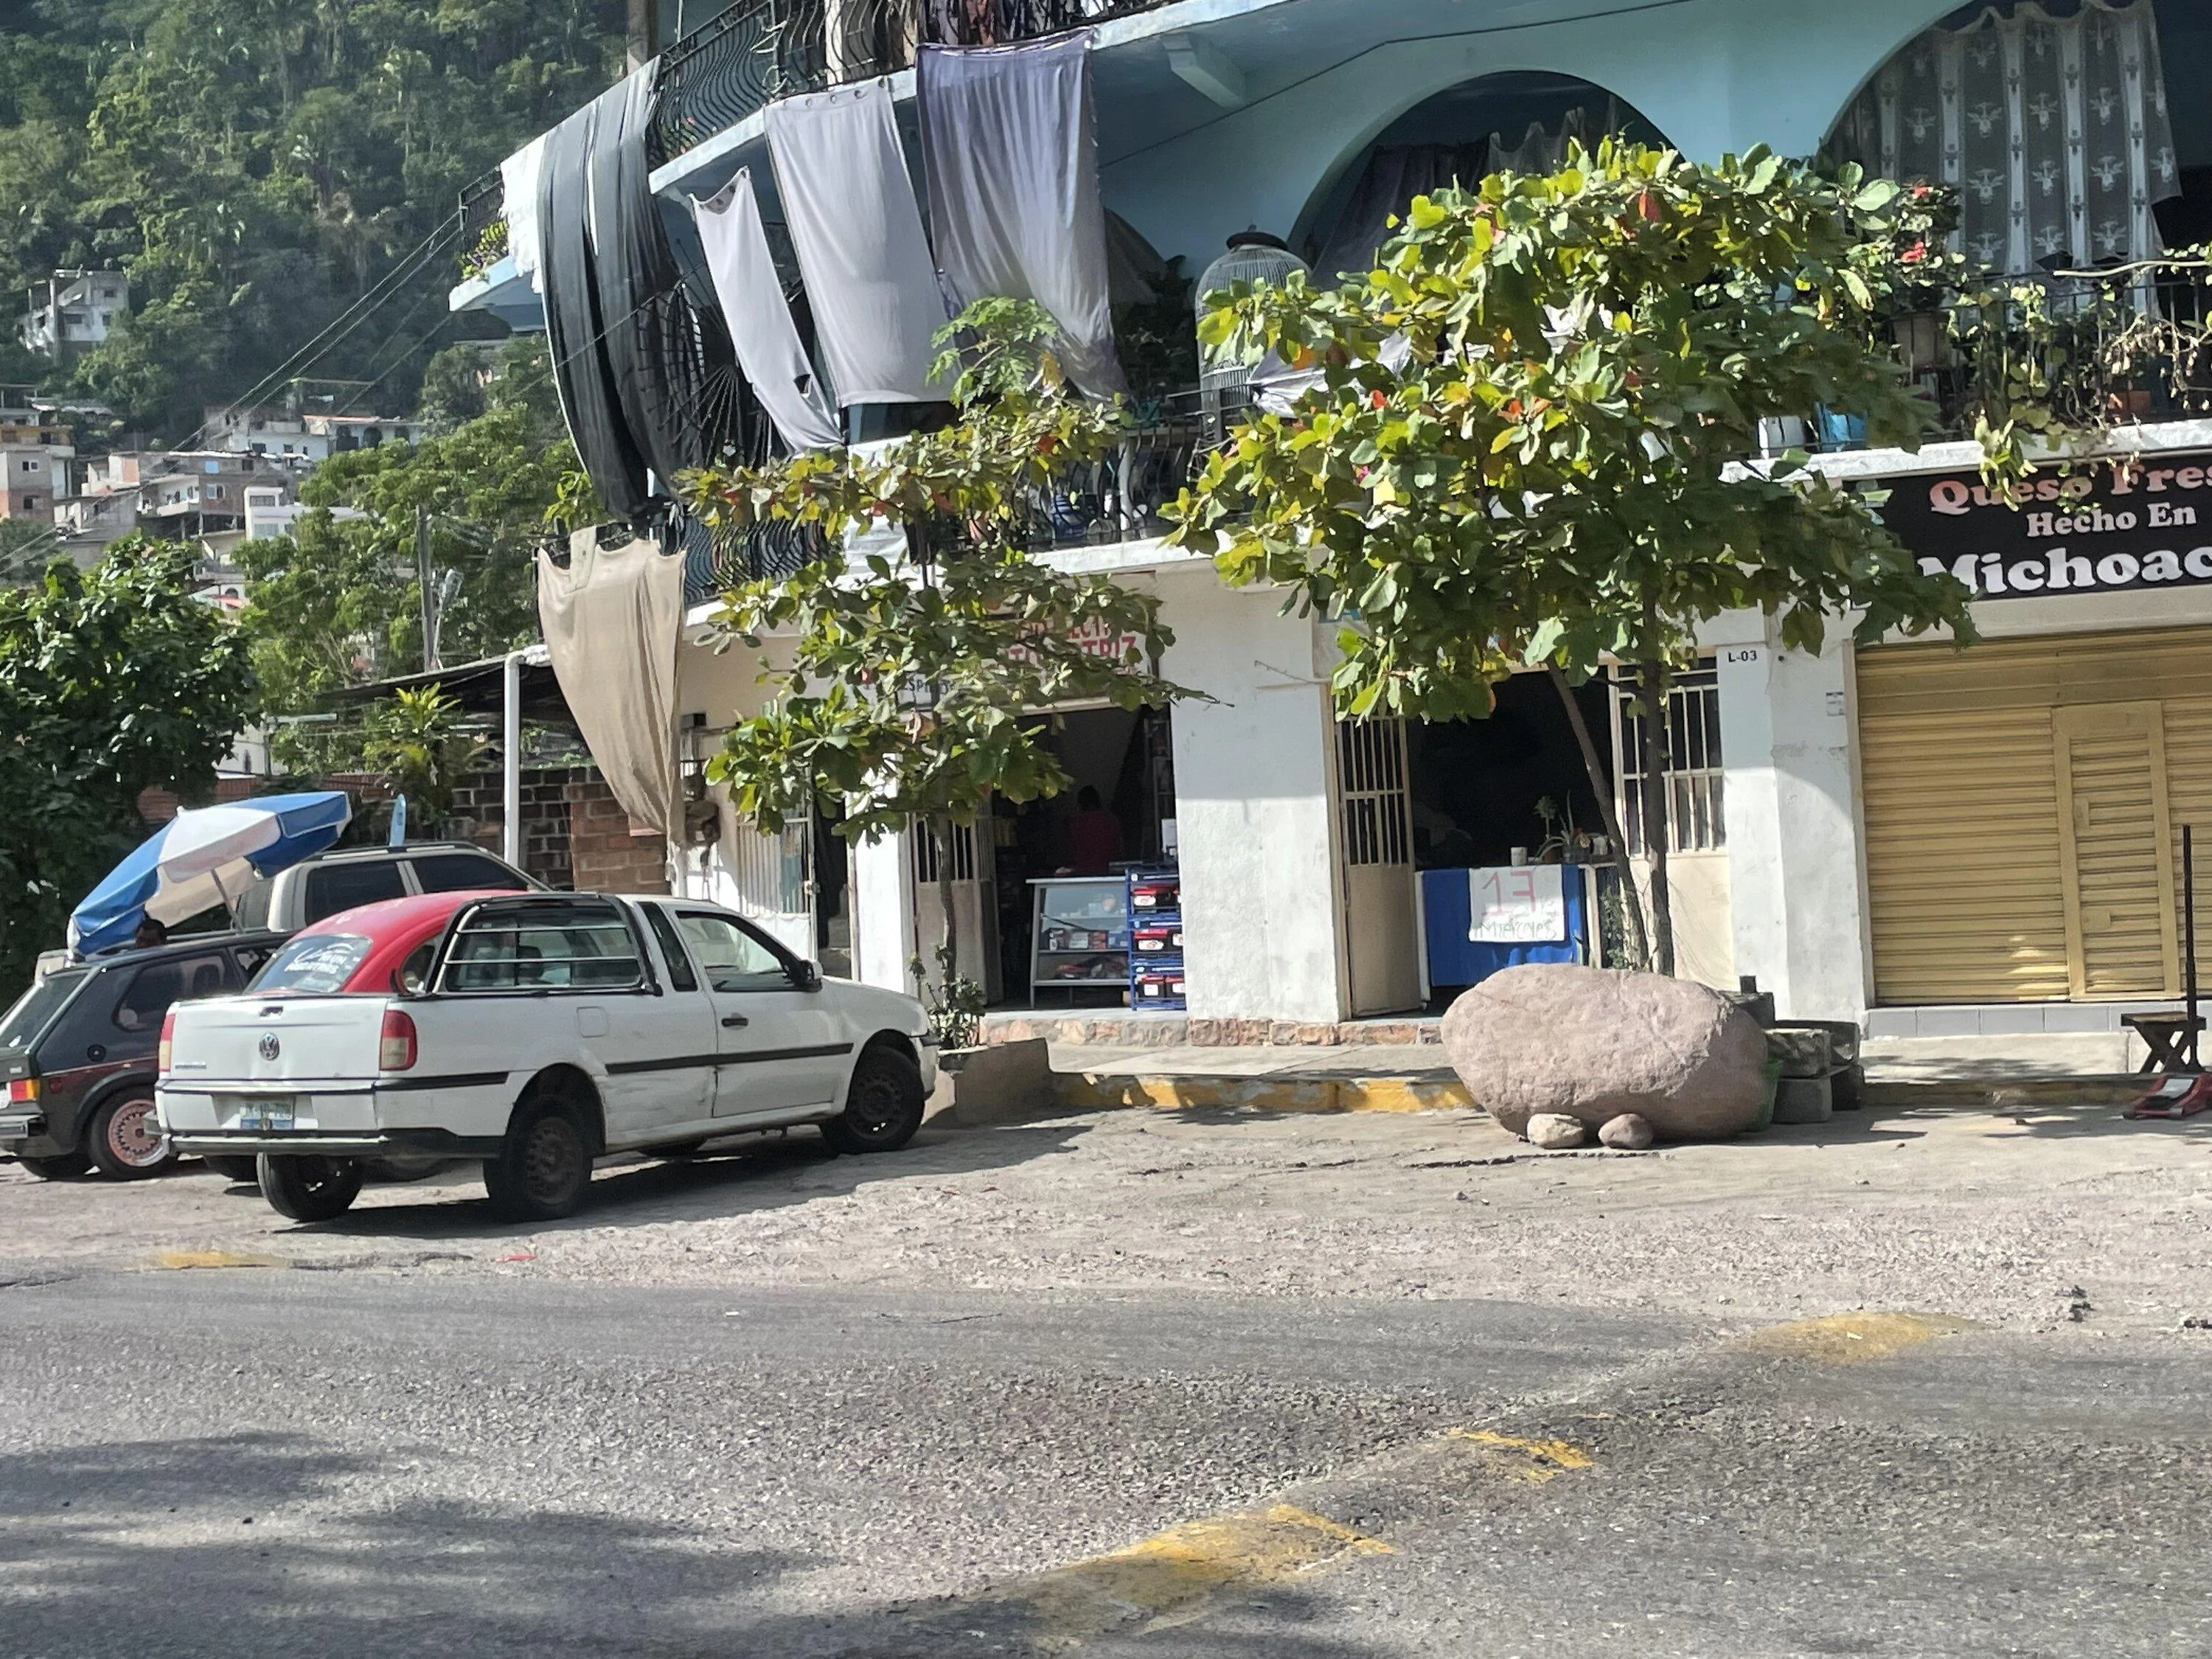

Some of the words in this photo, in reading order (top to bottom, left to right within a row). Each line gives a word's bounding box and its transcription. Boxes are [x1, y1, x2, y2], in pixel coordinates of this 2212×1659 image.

[1930, 477, 2093, 515] Queso
[2027, 509, 2137, 538] Hecho
[2147, 502, 2197, 527] En
[1728, 650, 1758, 662] L-03
